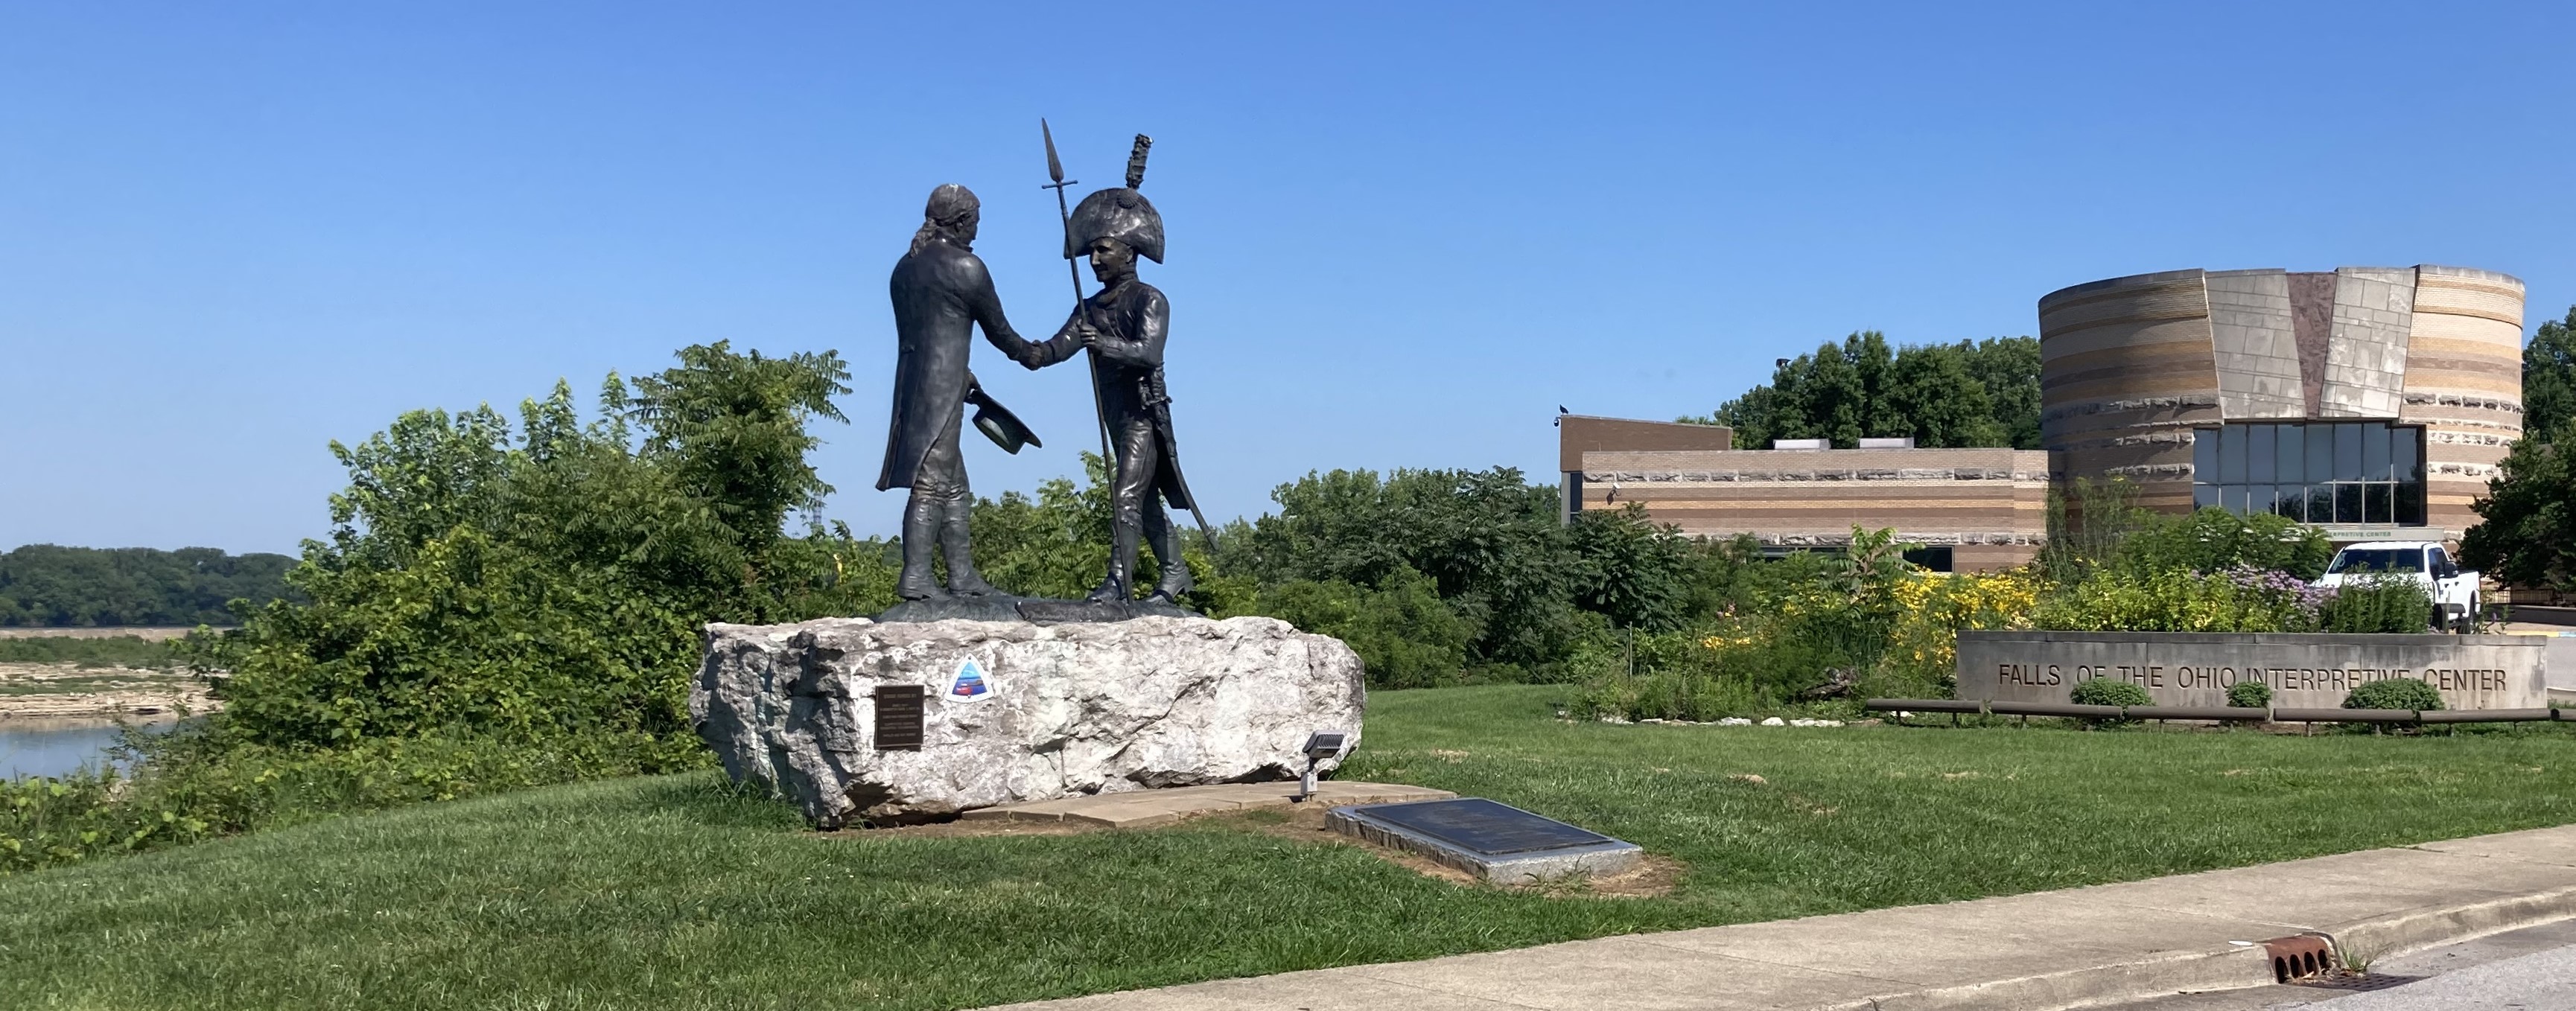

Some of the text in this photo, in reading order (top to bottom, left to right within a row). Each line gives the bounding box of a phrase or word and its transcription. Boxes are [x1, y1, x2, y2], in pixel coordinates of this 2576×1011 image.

[1999, 664, 2061, 686] FALLS
[2076, 665, 2106, 683] OF
[2117, 666, 2163, 689] THE
[2178, 666, 2236, 689] OHIO
[2423, 668, 2507, 692] CENTER
